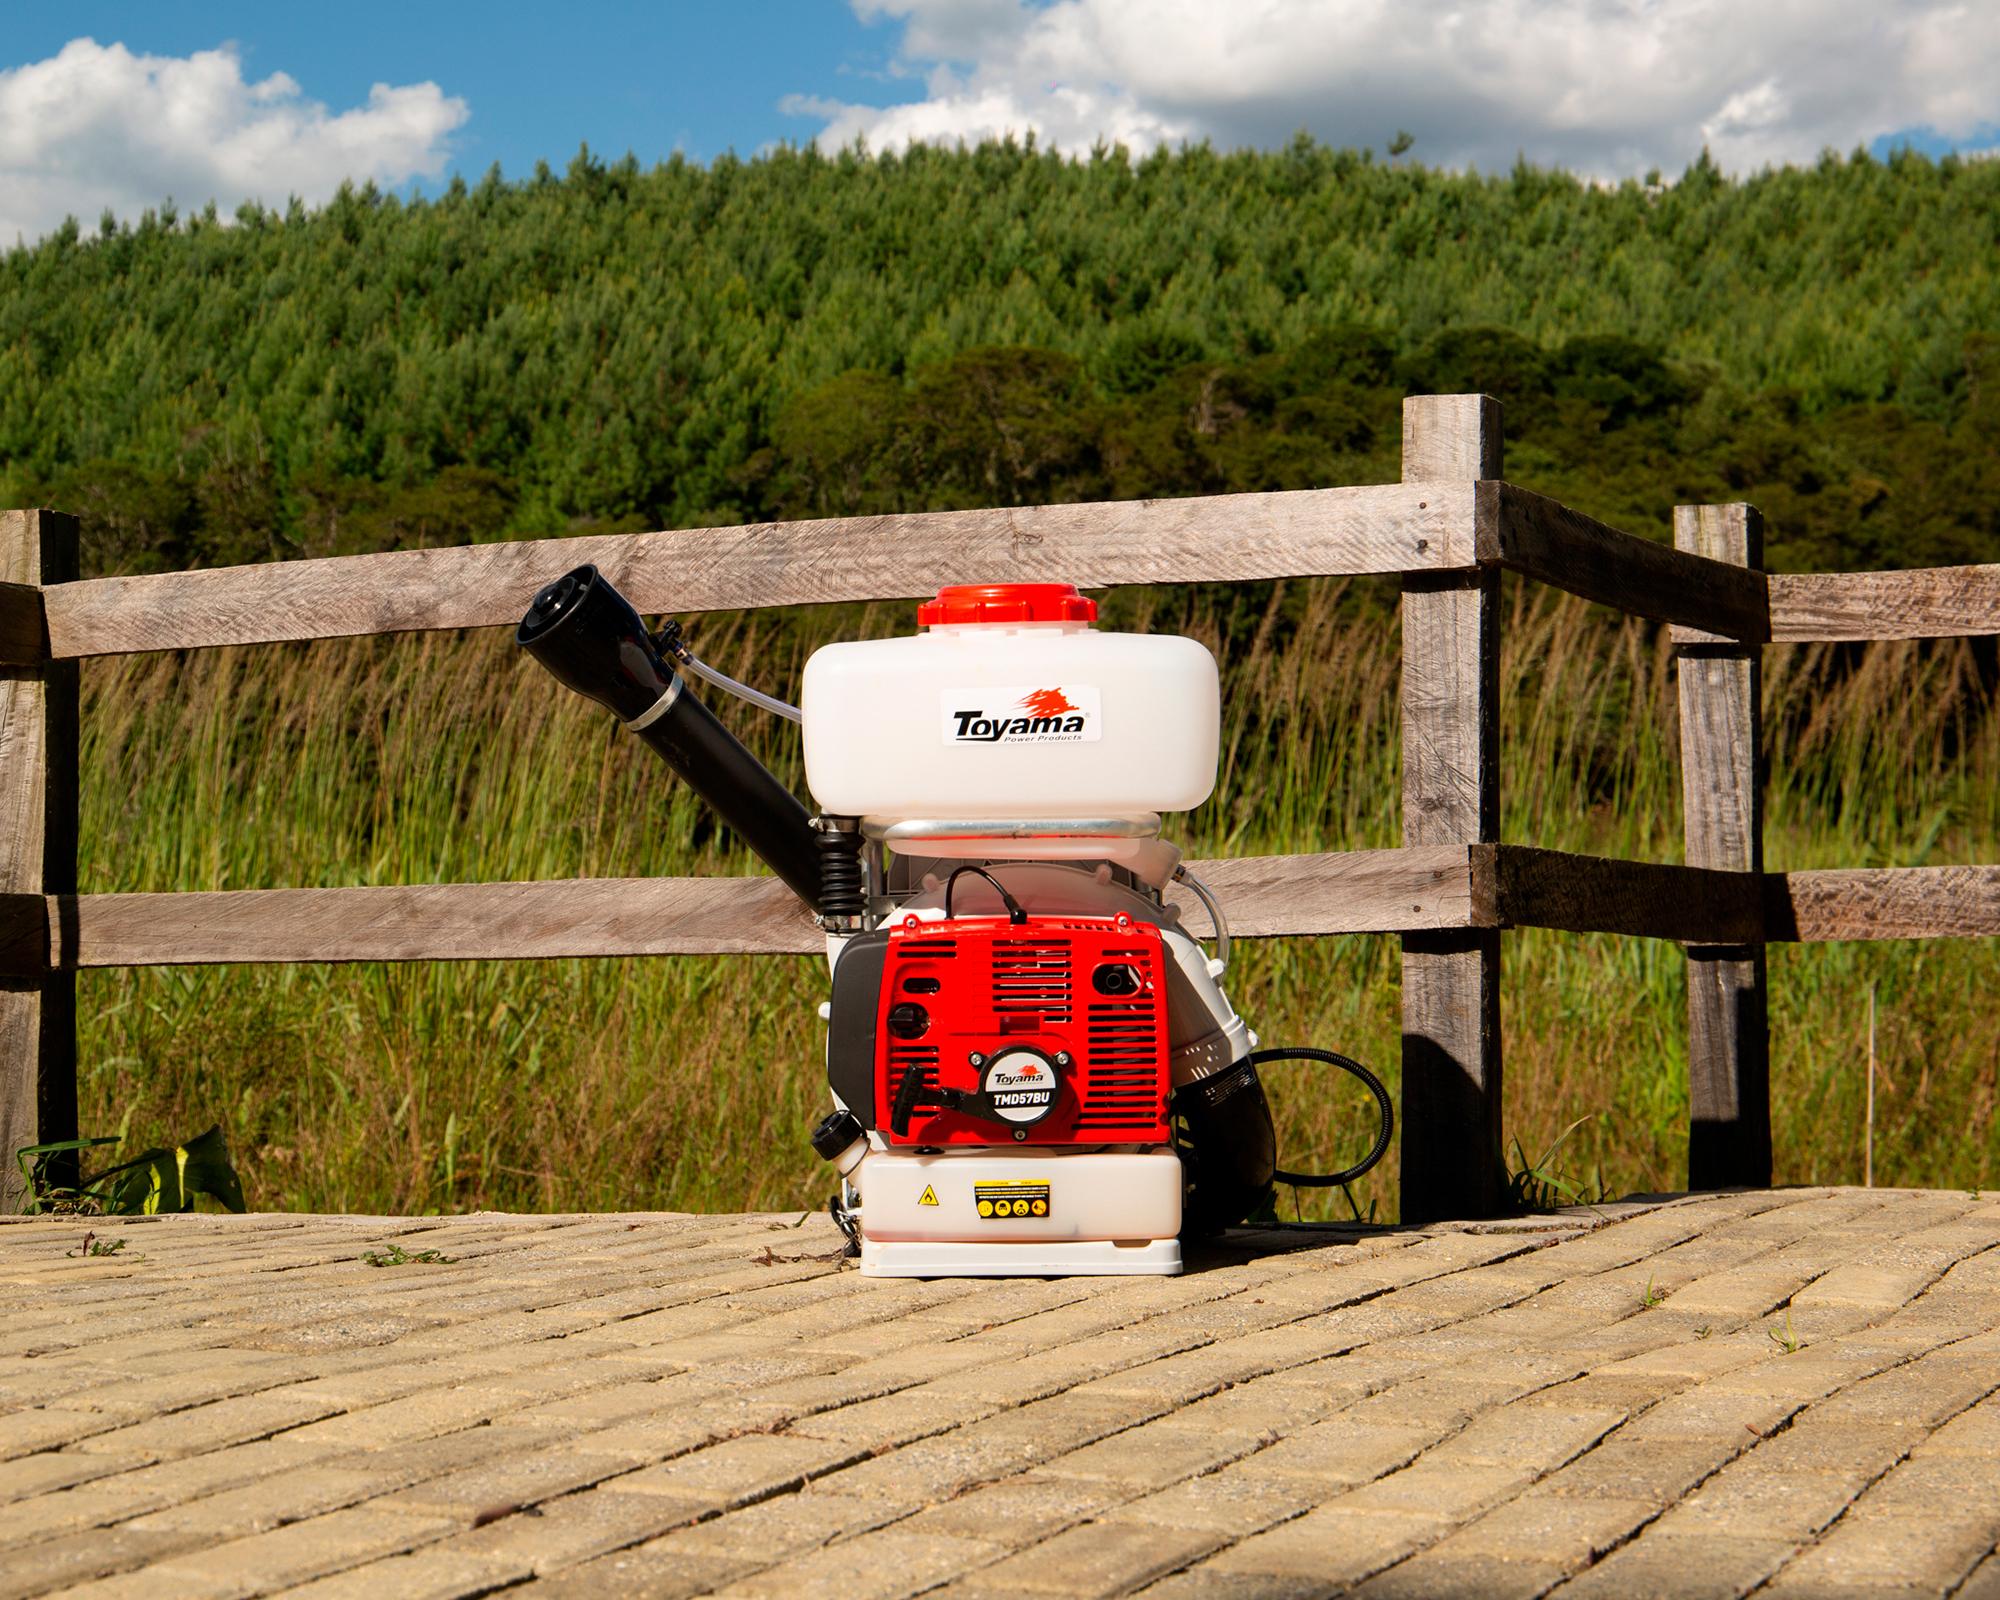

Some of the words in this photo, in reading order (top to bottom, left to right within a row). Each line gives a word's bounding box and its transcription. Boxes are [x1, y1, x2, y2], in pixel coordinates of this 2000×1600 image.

[953, 711, 1085, 742] Toyama
[1037, 734, 1082, 742] Products
[995, 1073, 1044, 1085] Toyama
[994, 1092, 1050, 1106] TMD57BU
